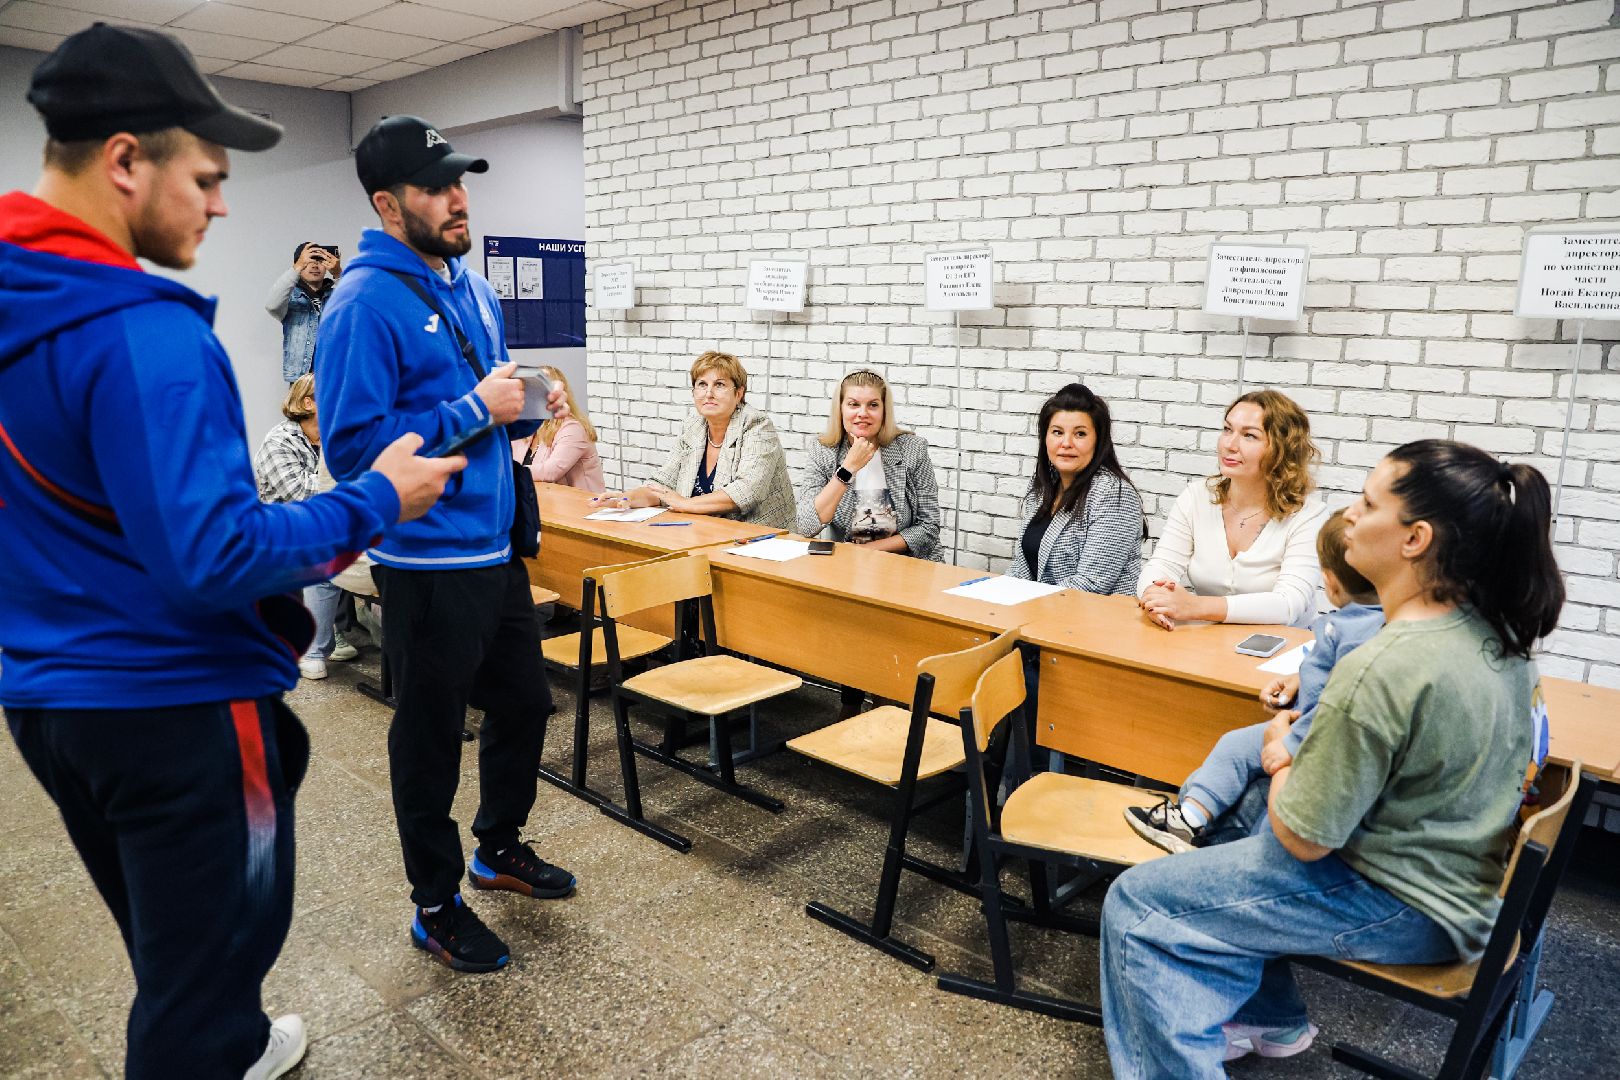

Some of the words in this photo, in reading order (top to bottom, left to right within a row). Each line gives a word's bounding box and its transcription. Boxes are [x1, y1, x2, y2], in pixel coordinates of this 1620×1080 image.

[539, 243, 566, 252] НАШИ
[1541, 287, 1573, 296] Ногай
[1554, 300, 1620, 310] Васильевна
